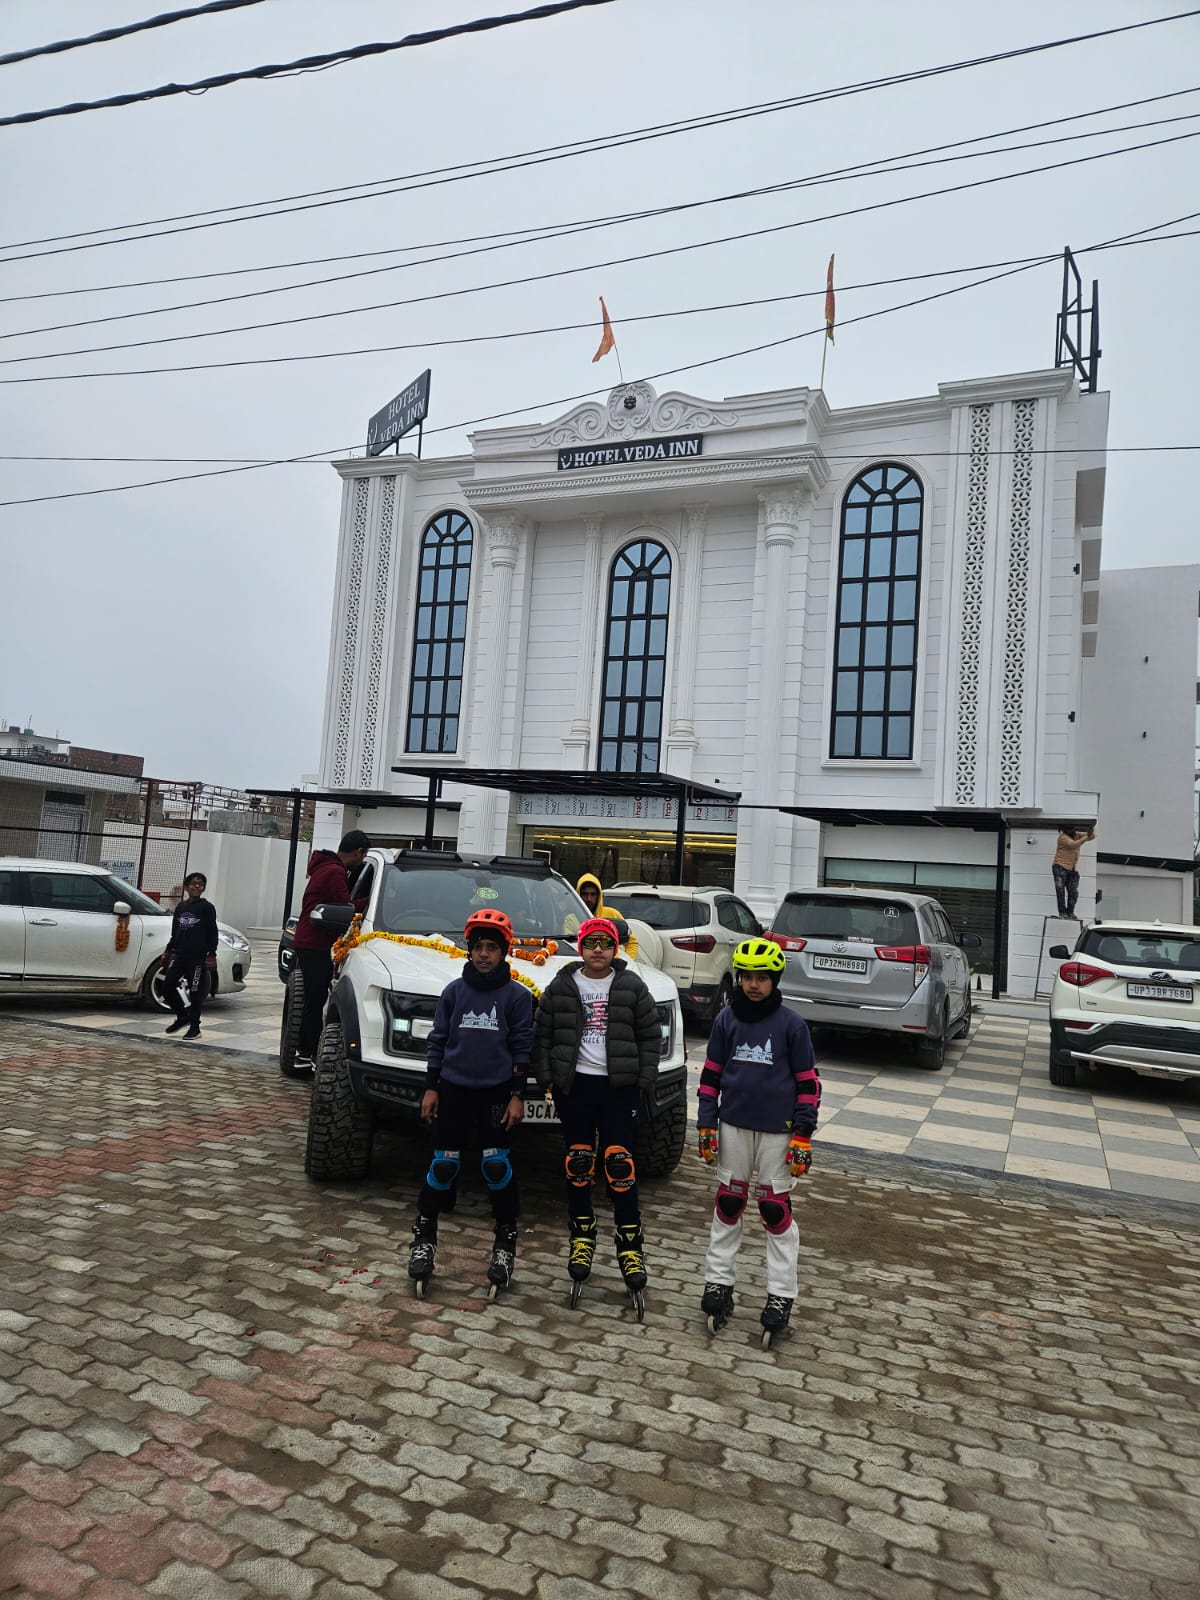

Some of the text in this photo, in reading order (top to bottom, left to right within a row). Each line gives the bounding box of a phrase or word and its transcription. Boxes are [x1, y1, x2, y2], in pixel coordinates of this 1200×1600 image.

[388, 382, 420, 420] HOTEL
[381, 416, 404, 444] VEDA
[406, 398, 425, 425] INN
[574, 448, 622, 467] HOTEL
[624, 444, 666, 461] VEDA
[668, 440, 699, 457] INN
